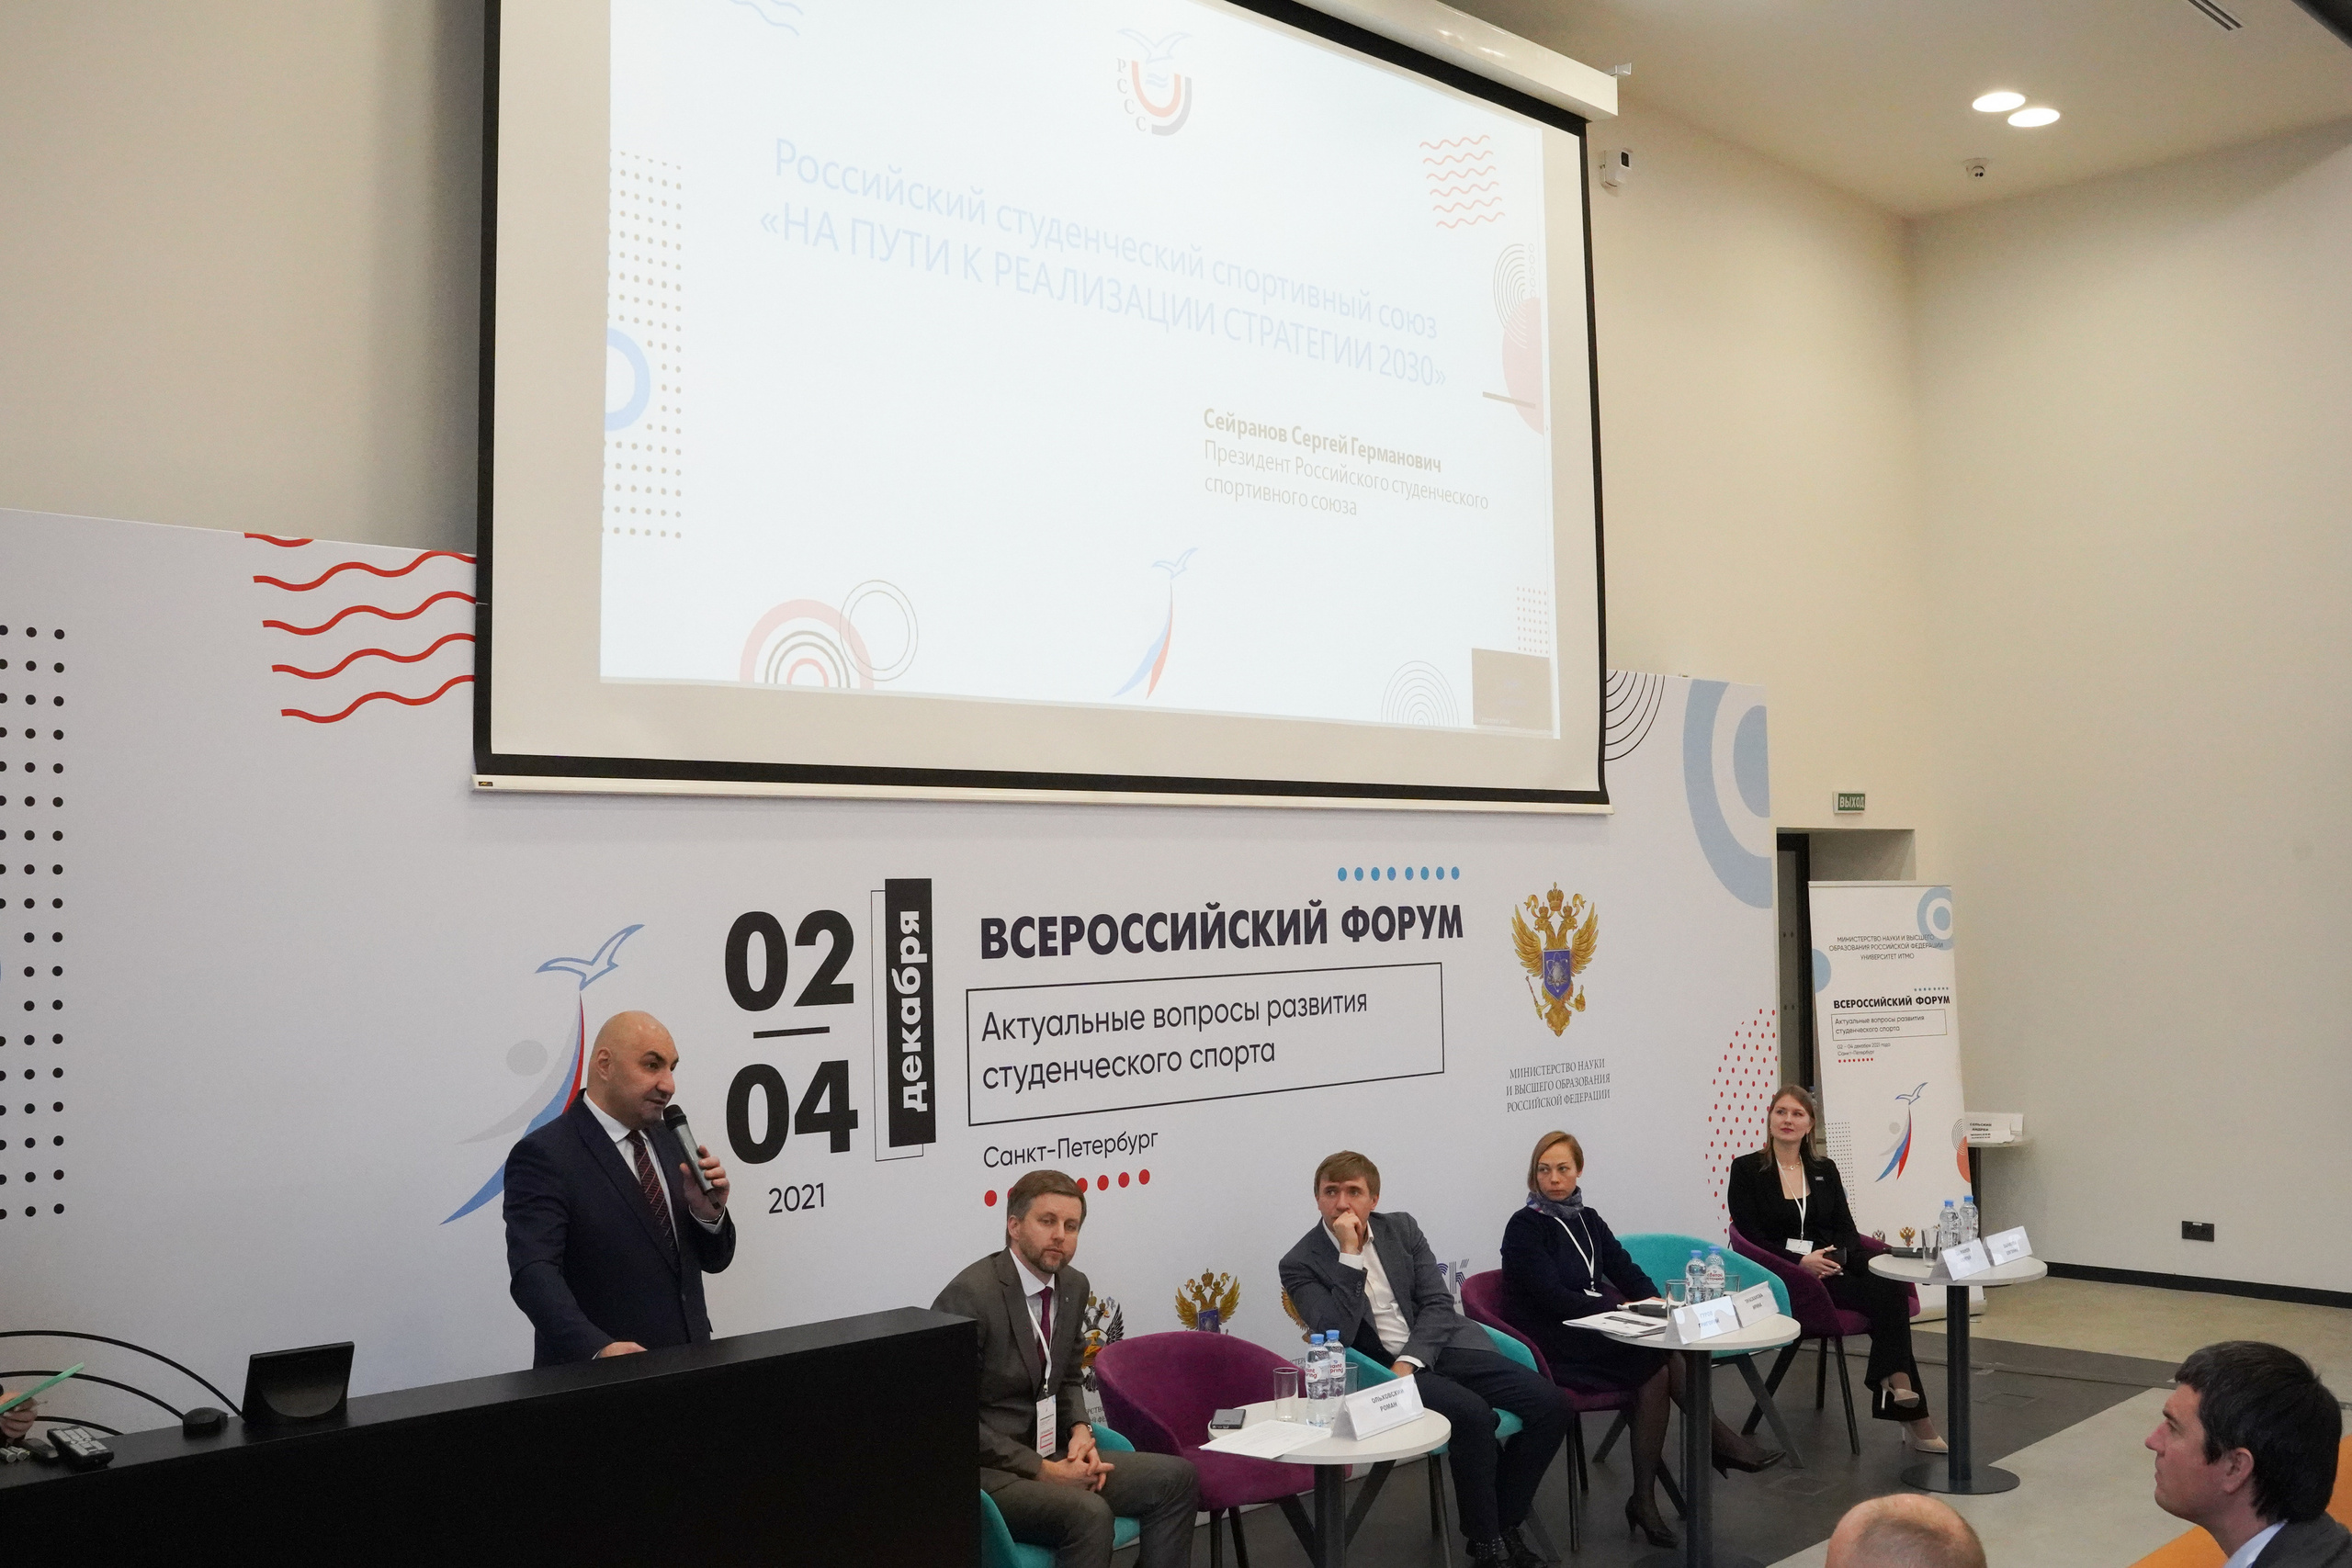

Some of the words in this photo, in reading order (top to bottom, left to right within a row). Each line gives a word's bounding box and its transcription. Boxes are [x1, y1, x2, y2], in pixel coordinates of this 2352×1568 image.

[775, 137, 986, 226] Российский
[996, 204, 1204, 280] студенческий
[1213, 260, 1371, 322] спортивный
[1378, 304, 1438, 339] союз
[761, 202, 840, 253] «НА
[851, 217, 950, 276] ПУТИ
[963, 243, 983, 283] К
[995, 251, 1216, 335] РЕАЛИЗАЦИИ
[1224, 307, 1372, 372] СТРАТЕГИИ
[1378, 344, 1447, 386] 2030»
[1204, 409, 1287, 443] Сейранов
[1292, 425, 1349, 455] Сергей
[1351, 437, 1442, 473] Германович
[1204, 439, 1290, 474] Президент
[1295, 457, 1389, 491] Российского
[1392, 479, 1488, 511] студенческого
[1204, 477, 1308, 508] спортивного
[1311, 494, 1357, 515] союза
[1839, 796, 1865, 808] ВЫХОД
[980, 898, 1329, 960] ВСЕРОССИЙСКИЙ
[1340, 904, 1464, 943] ФОРУМ
[1910, 942, 1944, 950] ФЕДЕРАЦИИ
[725, 909, 854, 1011] 02
[891, 910, 928, 1112] декабря
[981, 1009, 1146, 1046] Актуальные
[1153, 1000, 1261, 1032] вопросы
[1267, 994, 1367, 1027] развития
[1833, 995, 1913, 1010] ВСЕРОССИЙСКИЙ
[1915, 995, 1951, 1006] ФОРУМ
[1835, 1018, 1871, 1026] Актуальные
[1896, 1015, 1925, 1023] развития
[1835, 1026, 1879, 1035] студенческого
[1879, 1025, 1901, 1033] спорта
[982, 1050, 1182, 1095] студенческого
[1189, 1042, 1275, 1073] спорта
[1506, 1086, 1512, 1096] И
[1514, 1080, 1554, 1096] ВЫСШЕГО
[1555, 1073, 1611, 1090] ОБРАЗОВАНИЯ
[1510, 1062, 1576, 1079] МИНИСТЕРСТВО
[1577, 1058, 1605, 1072] НАУКИ
[726, 1059, 859, 1165] 04
[1507, 1094, 1563, 1113] РОССИЙСКОЙ
[1564, 1089, 1611, 1105] ФЕДЕРАЦИИ
[983, 1131, 1159, 1168] Санкт-Петербург
[768, 1181, 826, 1214] 2021
